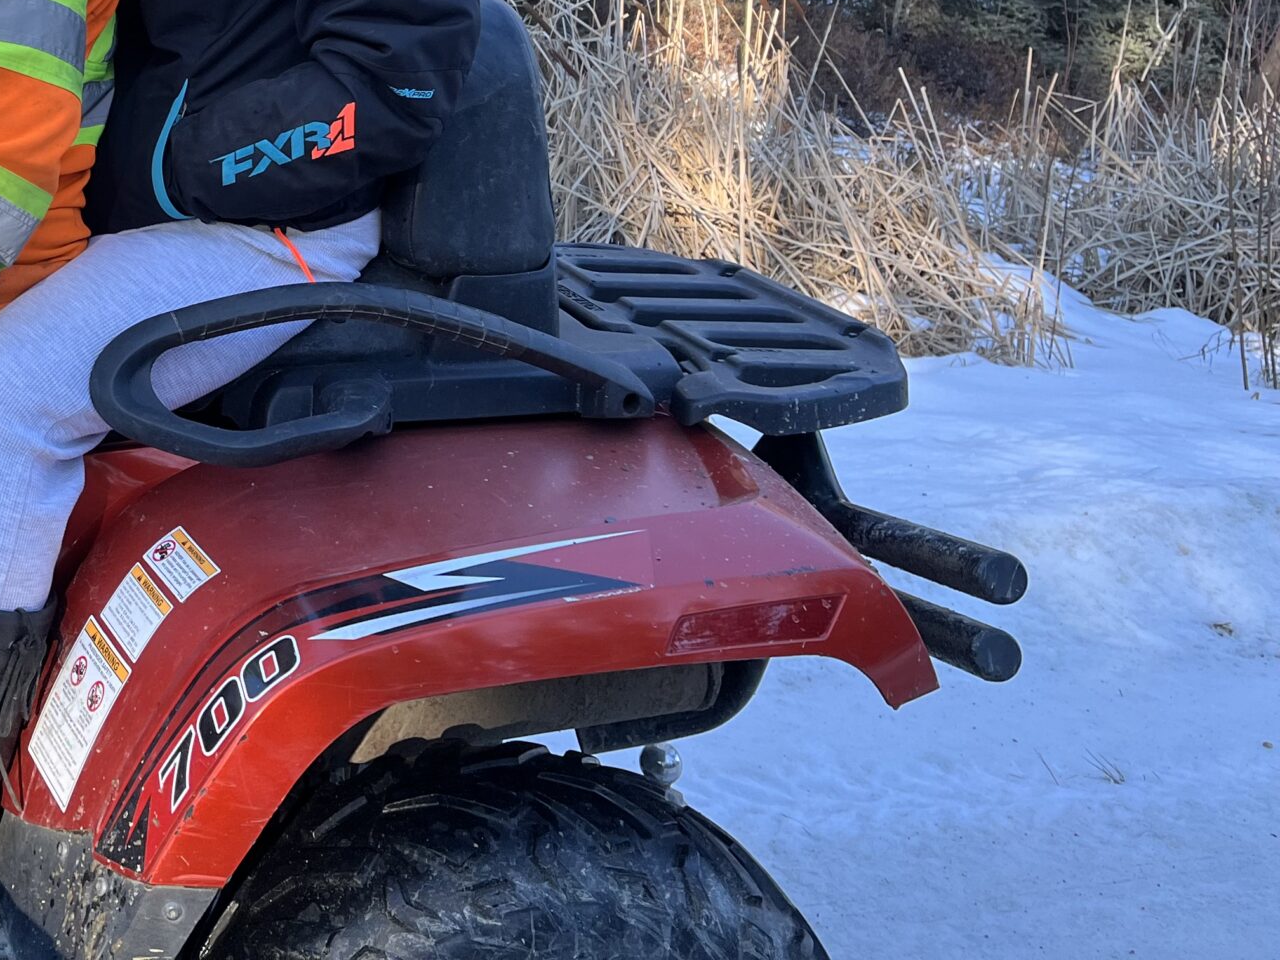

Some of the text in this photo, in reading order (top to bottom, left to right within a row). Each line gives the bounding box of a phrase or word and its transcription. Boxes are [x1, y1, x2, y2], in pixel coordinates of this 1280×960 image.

[209, 120, 334, 187] FXR
[187, 544, 206, 565] WARNING
[141, 580, 164, 607] WARNING
[96, 638, 120, 671] WARNING
[158, 634, 301, 814] 700
